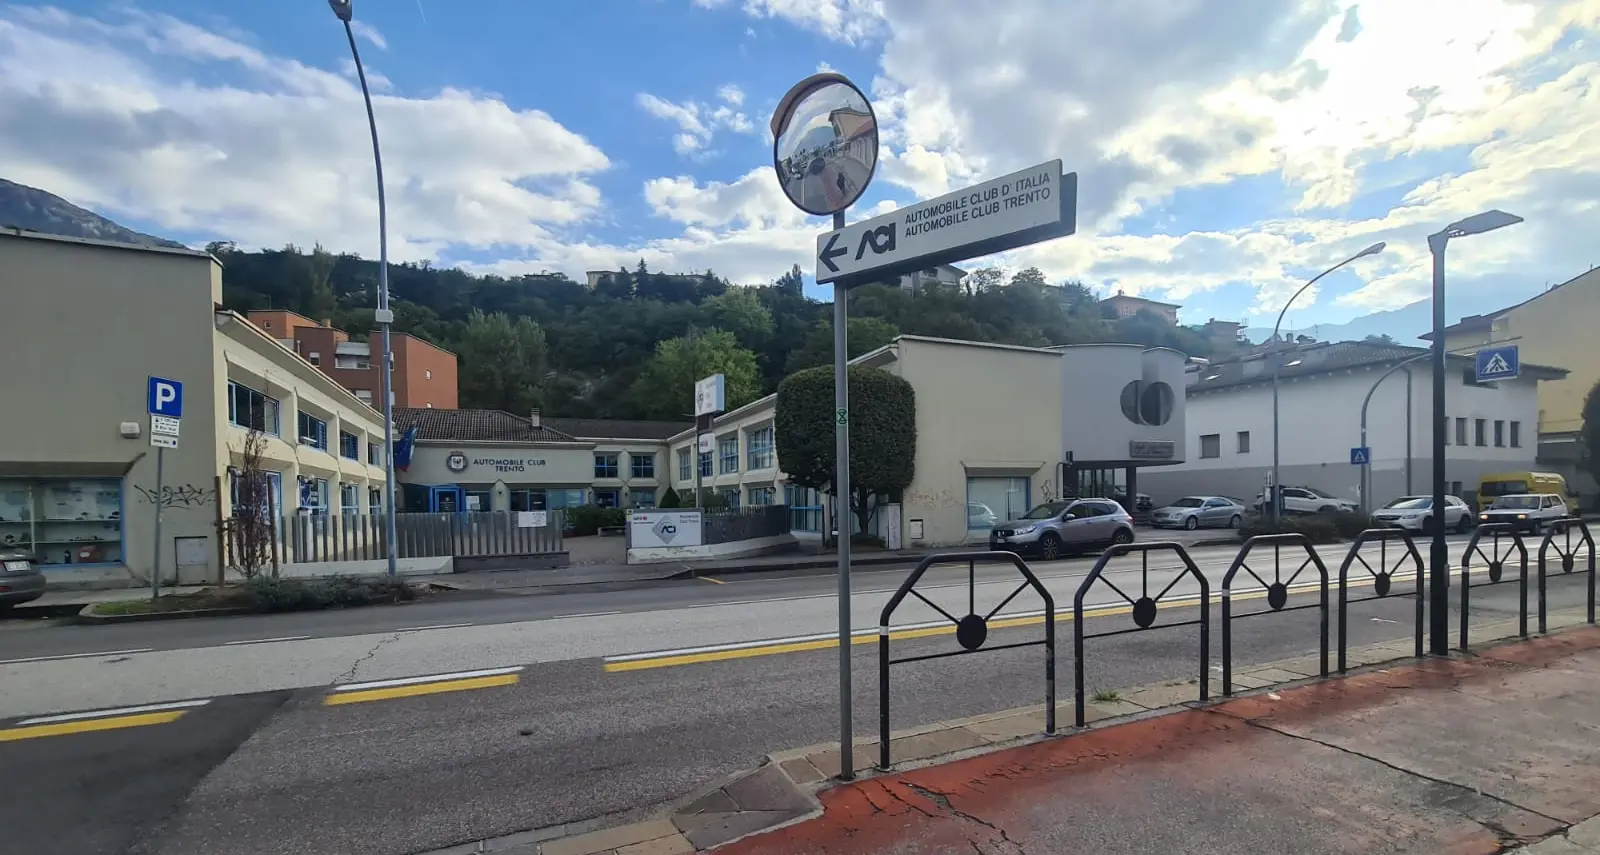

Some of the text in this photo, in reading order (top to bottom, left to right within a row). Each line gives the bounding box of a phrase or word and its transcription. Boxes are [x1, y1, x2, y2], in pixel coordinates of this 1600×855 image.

[905, 197, 967, 225] AUTOMOBILE
[970, 188, 998, 205] CLUB
[1015, 172, 1050, 191] ITALIA
[905, 187, 1050, 238] AUTOMOBILE CLUB TRENTO
[855, 222, 897, 261] ACI
[156, 382, 176, 410] P
[473, 458, 524, 466] AUTOMOBILE
[661, 525, 676, 534] ACI
